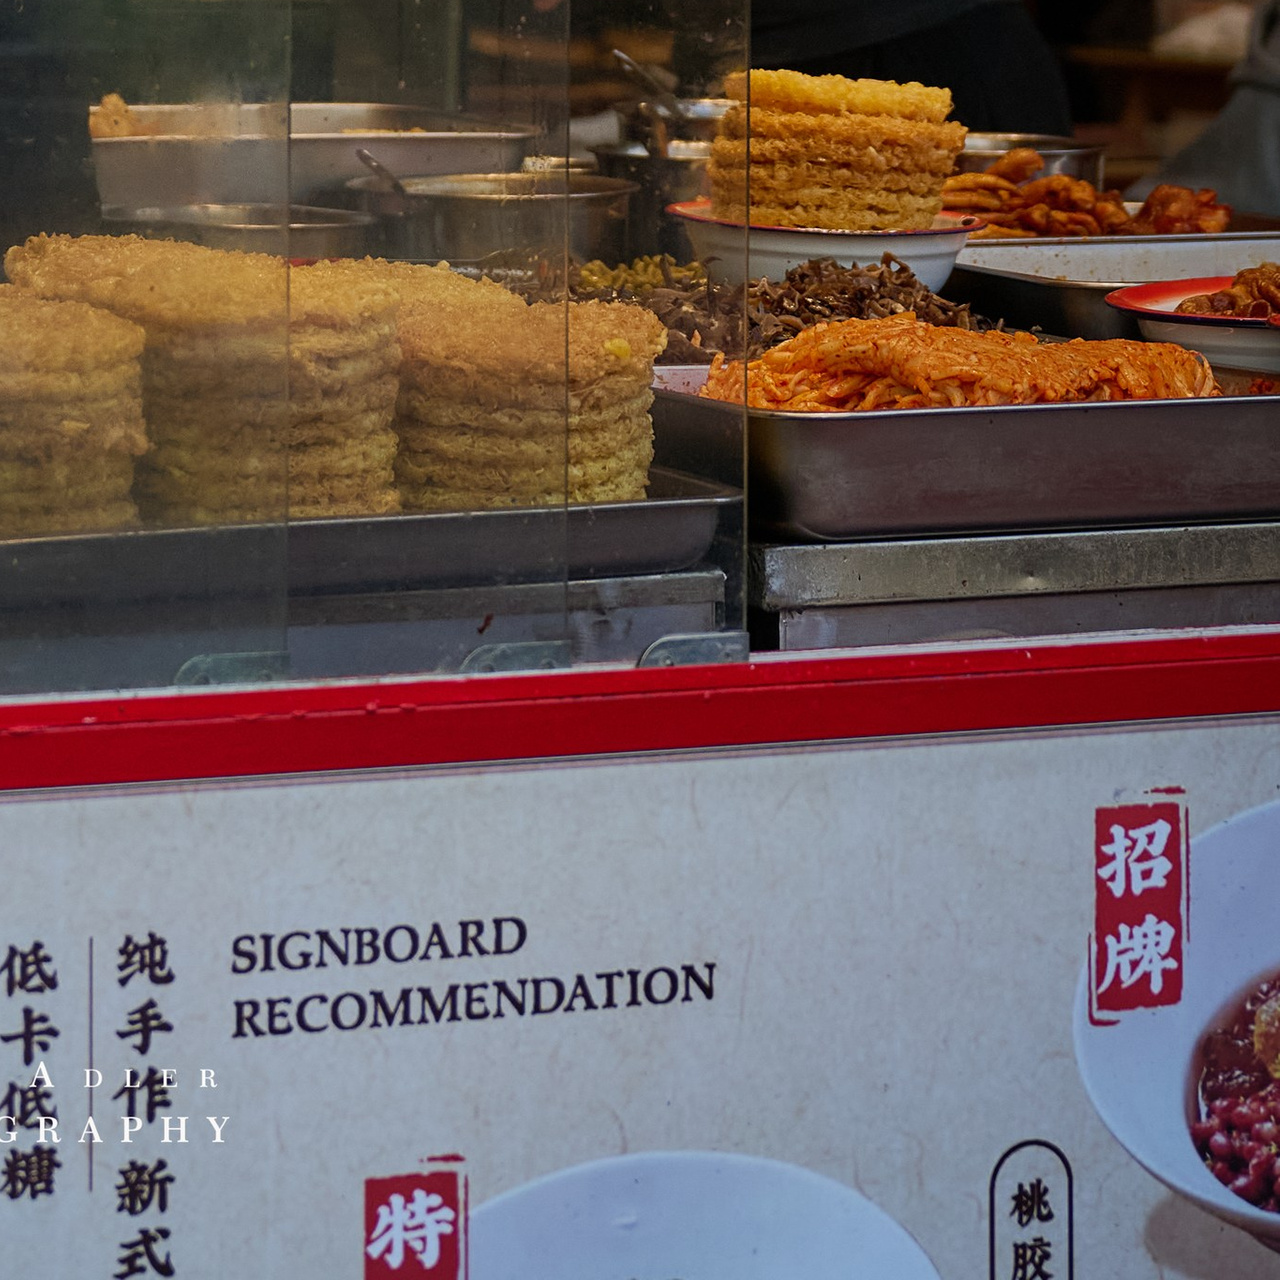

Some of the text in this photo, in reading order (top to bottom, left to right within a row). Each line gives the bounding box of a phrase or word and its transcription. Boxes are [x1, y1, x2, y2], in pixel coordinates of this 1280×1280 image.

[230, 916, 528, 975] SIGNBOARD
[1097, 818, 1180, 996] 招牌
[231, 962, 717, 1039] RECOMMENDATION
[365, 1188, 456, 1270] 特
[1009, 1177, 1056, 1280] 桃胶
